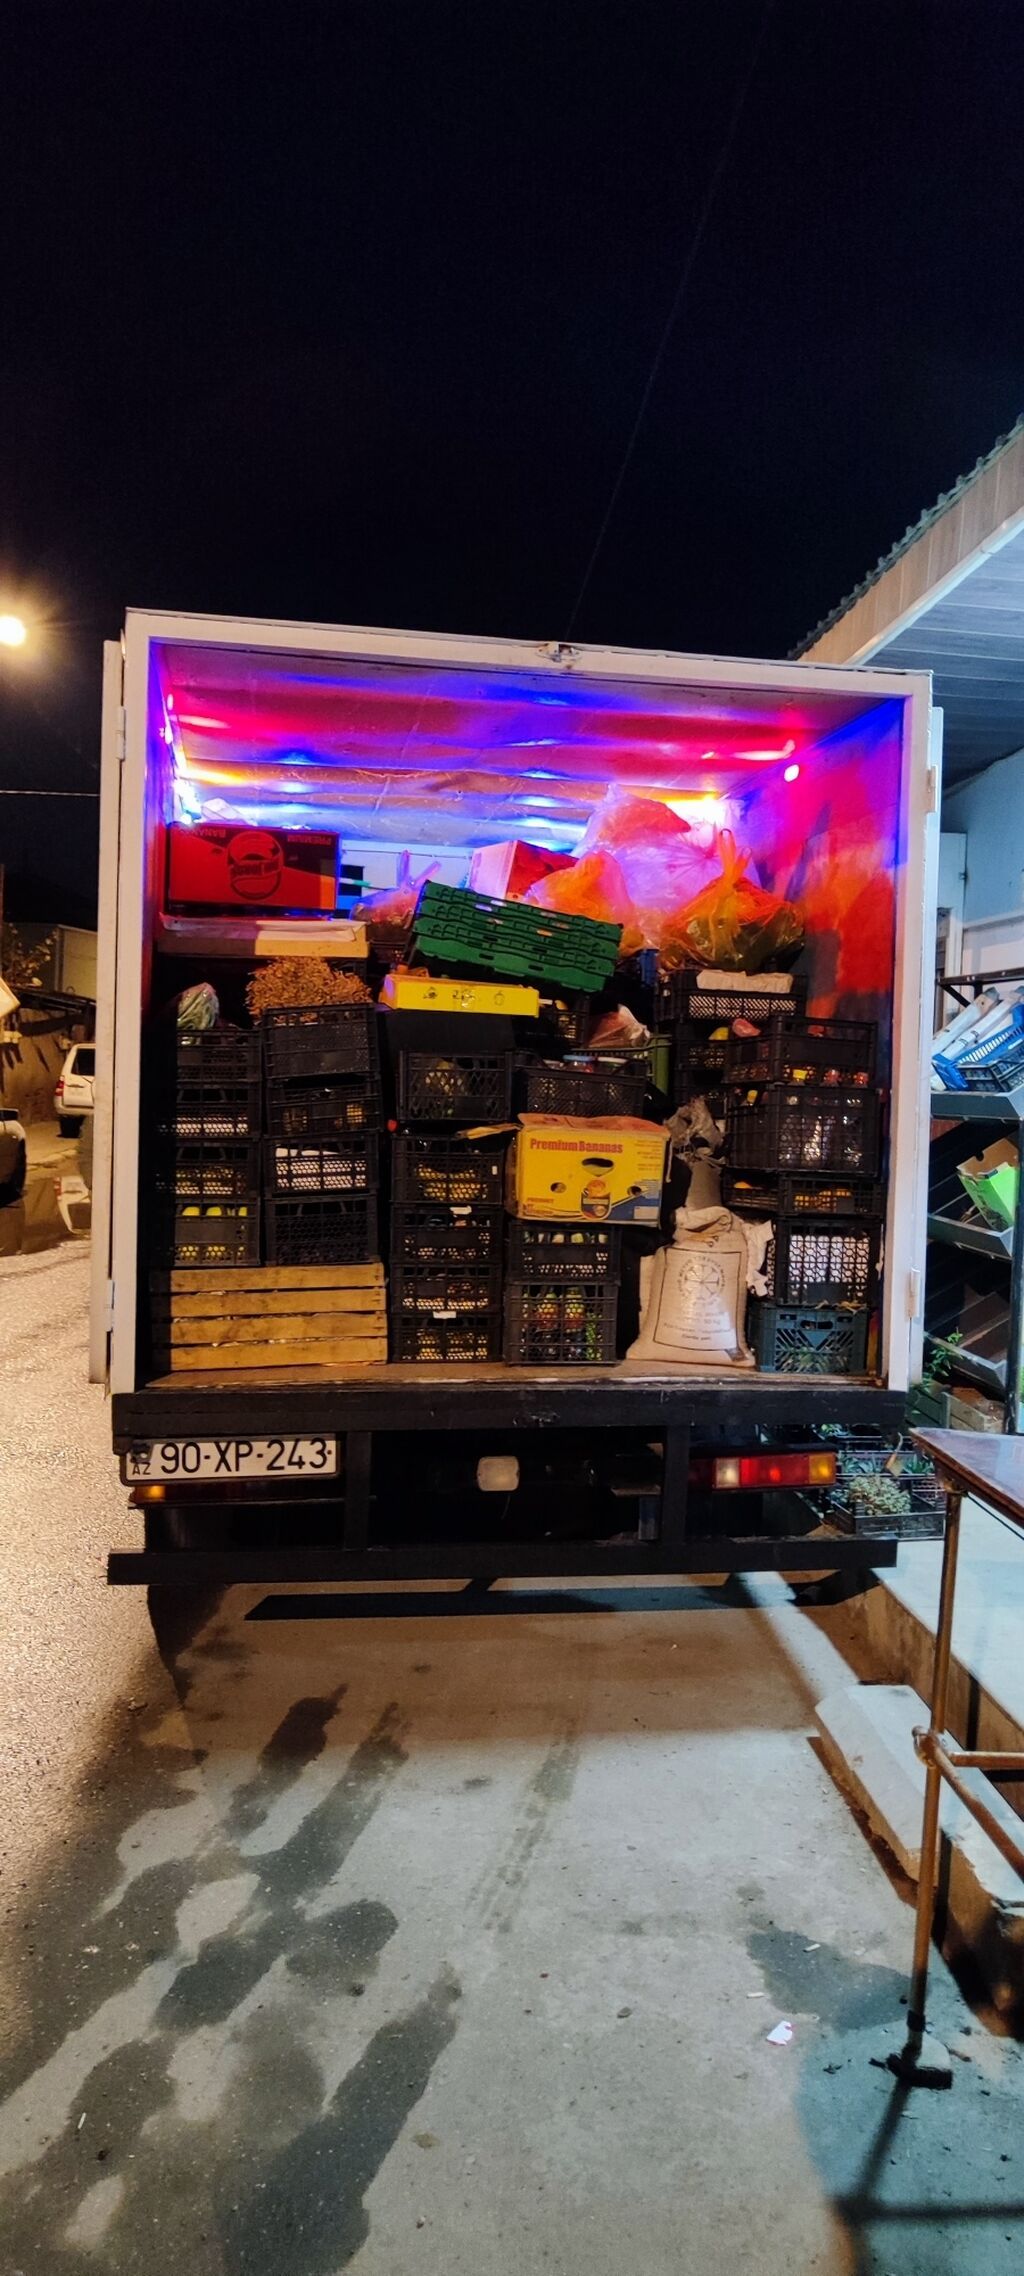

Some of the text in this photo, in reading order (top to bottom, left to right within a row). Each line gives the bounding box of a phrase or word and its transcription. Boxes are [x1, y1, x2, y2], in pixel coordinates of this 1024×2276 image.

[287, 834, 332, 846] PREMIUM
[530, 1138, 578, 1152] Premium
[579, 1140, 624, 1154] Bananas
[131, 1438, 327, 1475] AZ 90-XP-243
